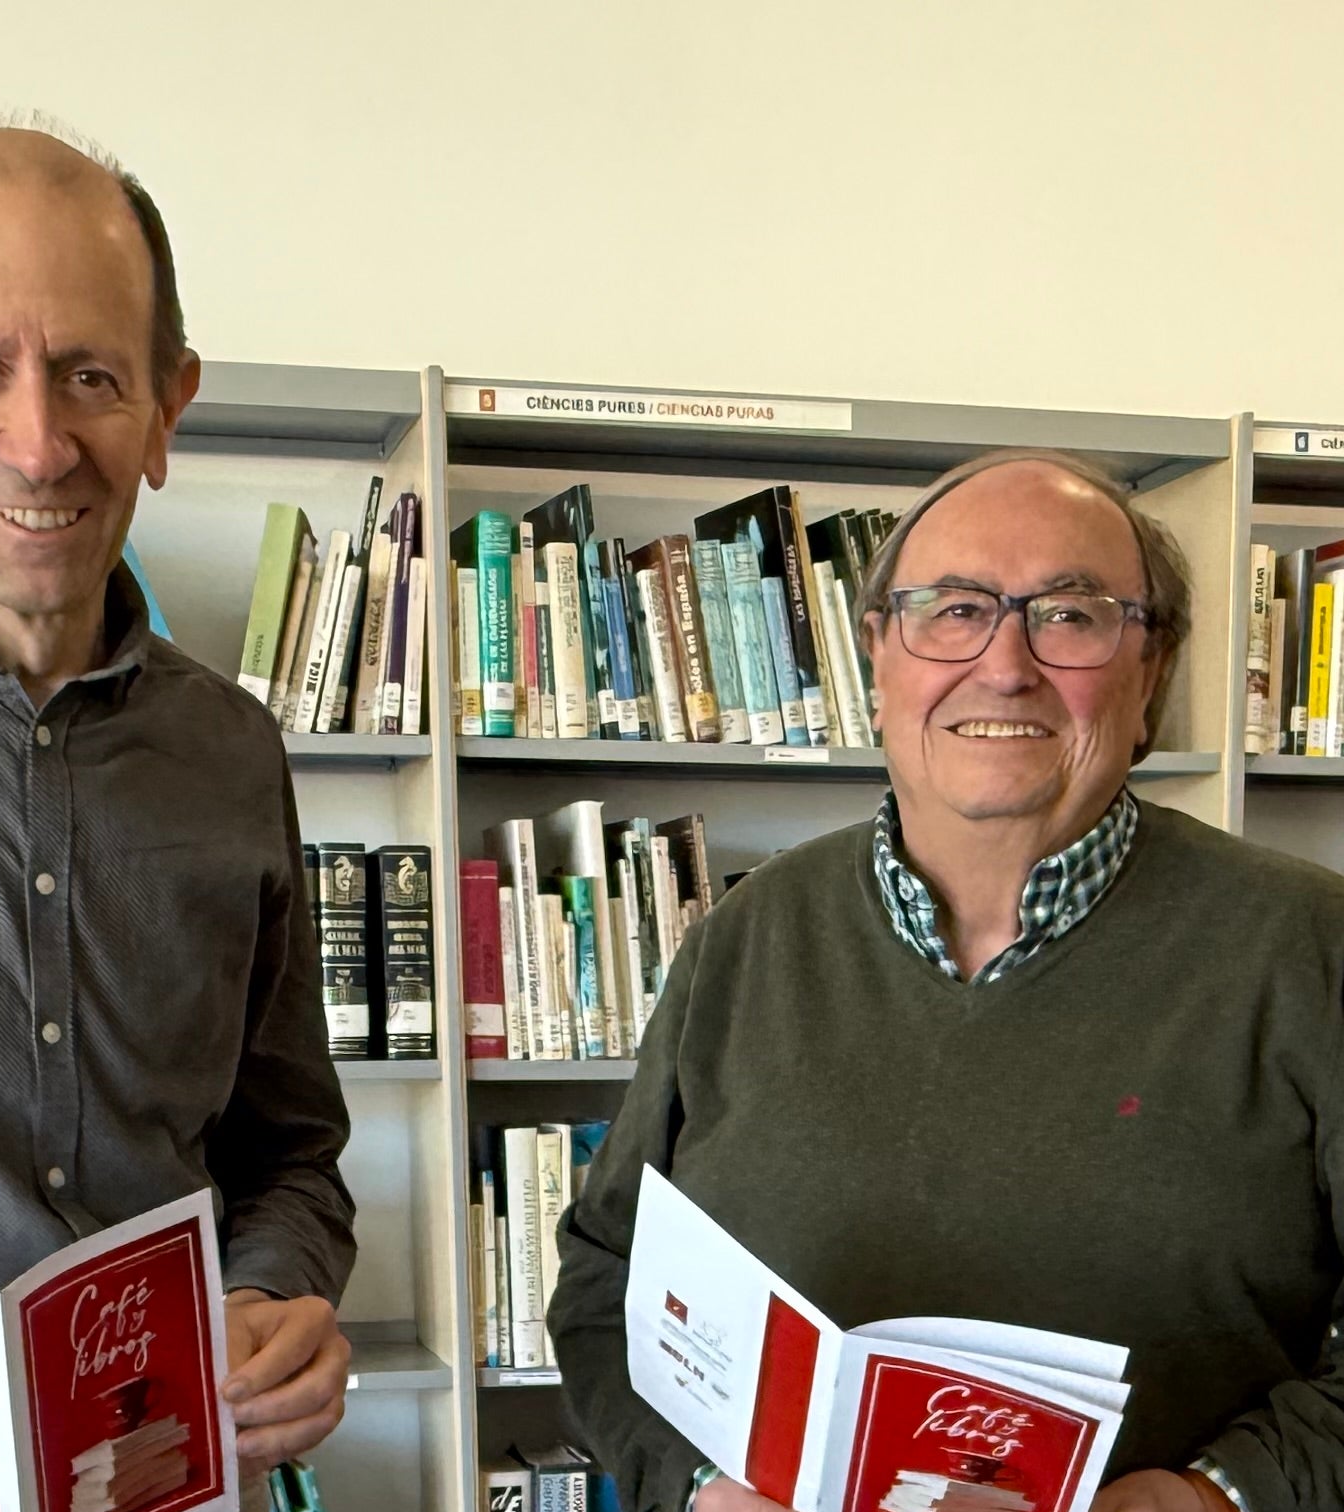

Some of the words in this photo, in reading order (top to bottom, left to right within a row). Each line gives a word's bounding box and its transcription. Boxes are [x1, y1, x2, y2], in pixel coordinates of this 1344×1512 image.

[598, 400, 646, 414] PURES
[657, 402, 723, 418] CIENCIAS
[727, 406, 774, 420] PURAS
[71, 1277, 155, 1351] Café
[71, 1330, 156, 1400] libros
[927, 1385, 1036, 1428] Café
[912, 1407, 1024, 1457] libros
